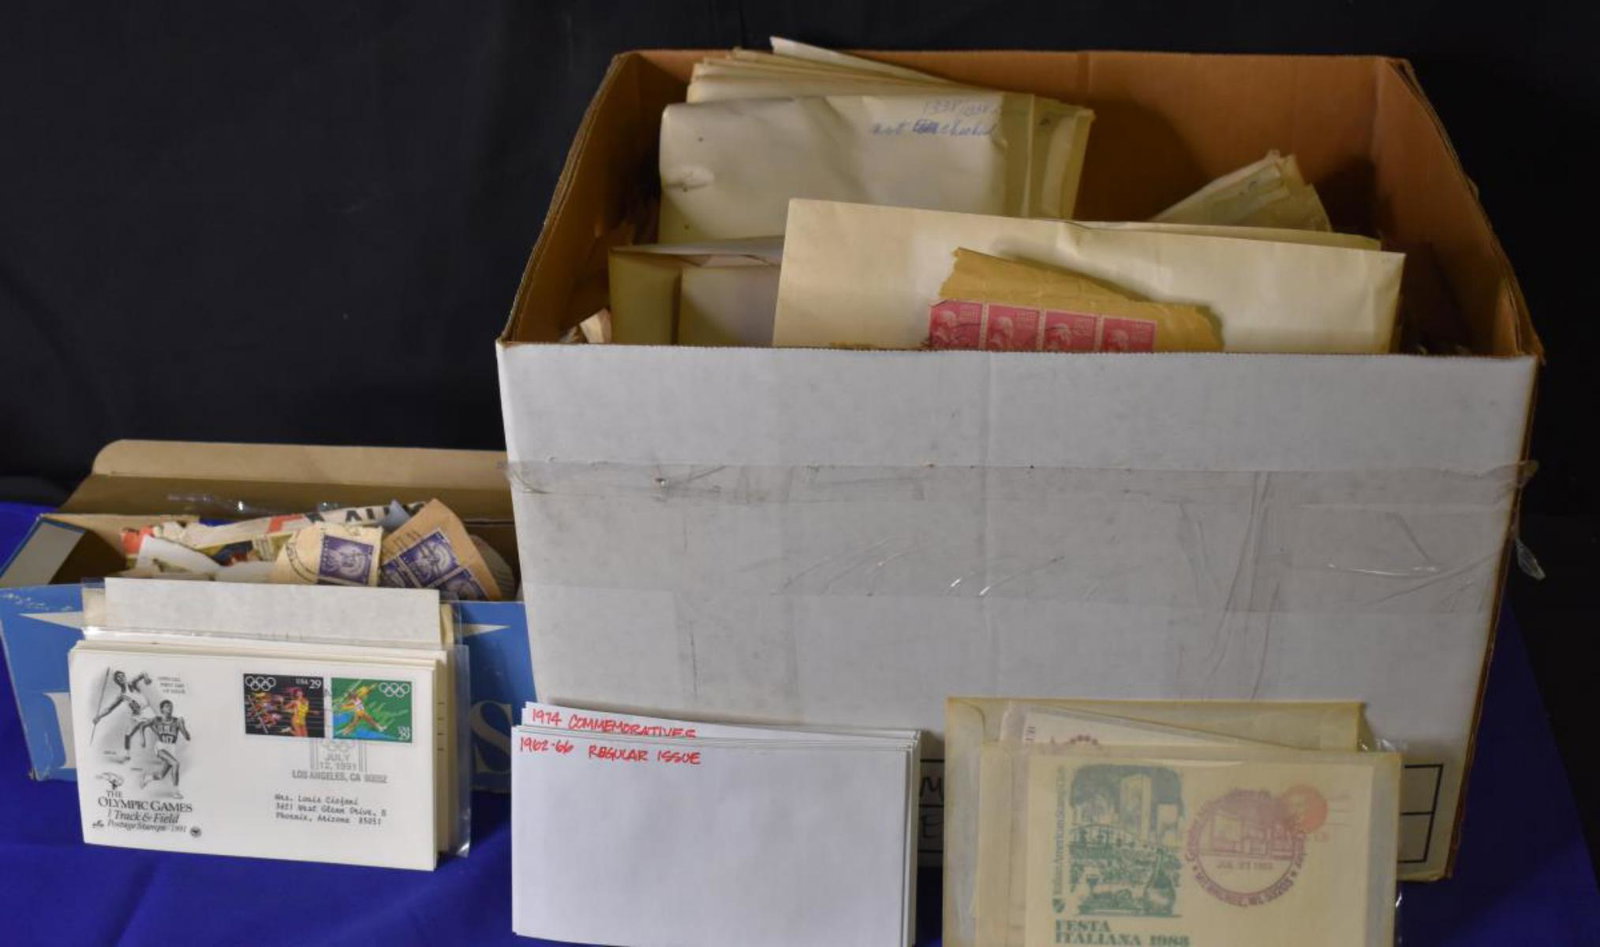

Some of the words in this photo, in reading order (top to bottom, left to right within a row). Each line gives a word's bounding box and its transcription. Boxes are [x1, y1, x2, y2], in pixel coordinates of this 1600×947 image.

[309, 679, 322, 689] 29
[532, 709, 562, 726] 1974
[325, 753, 350, 762] JULY
[588, 745, 648, 762] REGULAR
[657, 750, 702, 766] ISSUE
[292, 770, 308, 780] LOS
[309, 771, 348, 782] ANGELES,
[350, 773, 361, 782] CA
[107, 790, 122, 799] THE
[98, 796, 149, 811] OLYMPIC
[150, 799, 193, 813] GAMES
[113, 809, 142, 821] Track
[153, 813, 180, 825] Field
[276, 811, 312, 822] Phoenix,
[317, 815, 350, 824] Arizona
[1055, 919, 1111, 932] FESTA
[1055, 932, 1142, 945] ITALIANA
